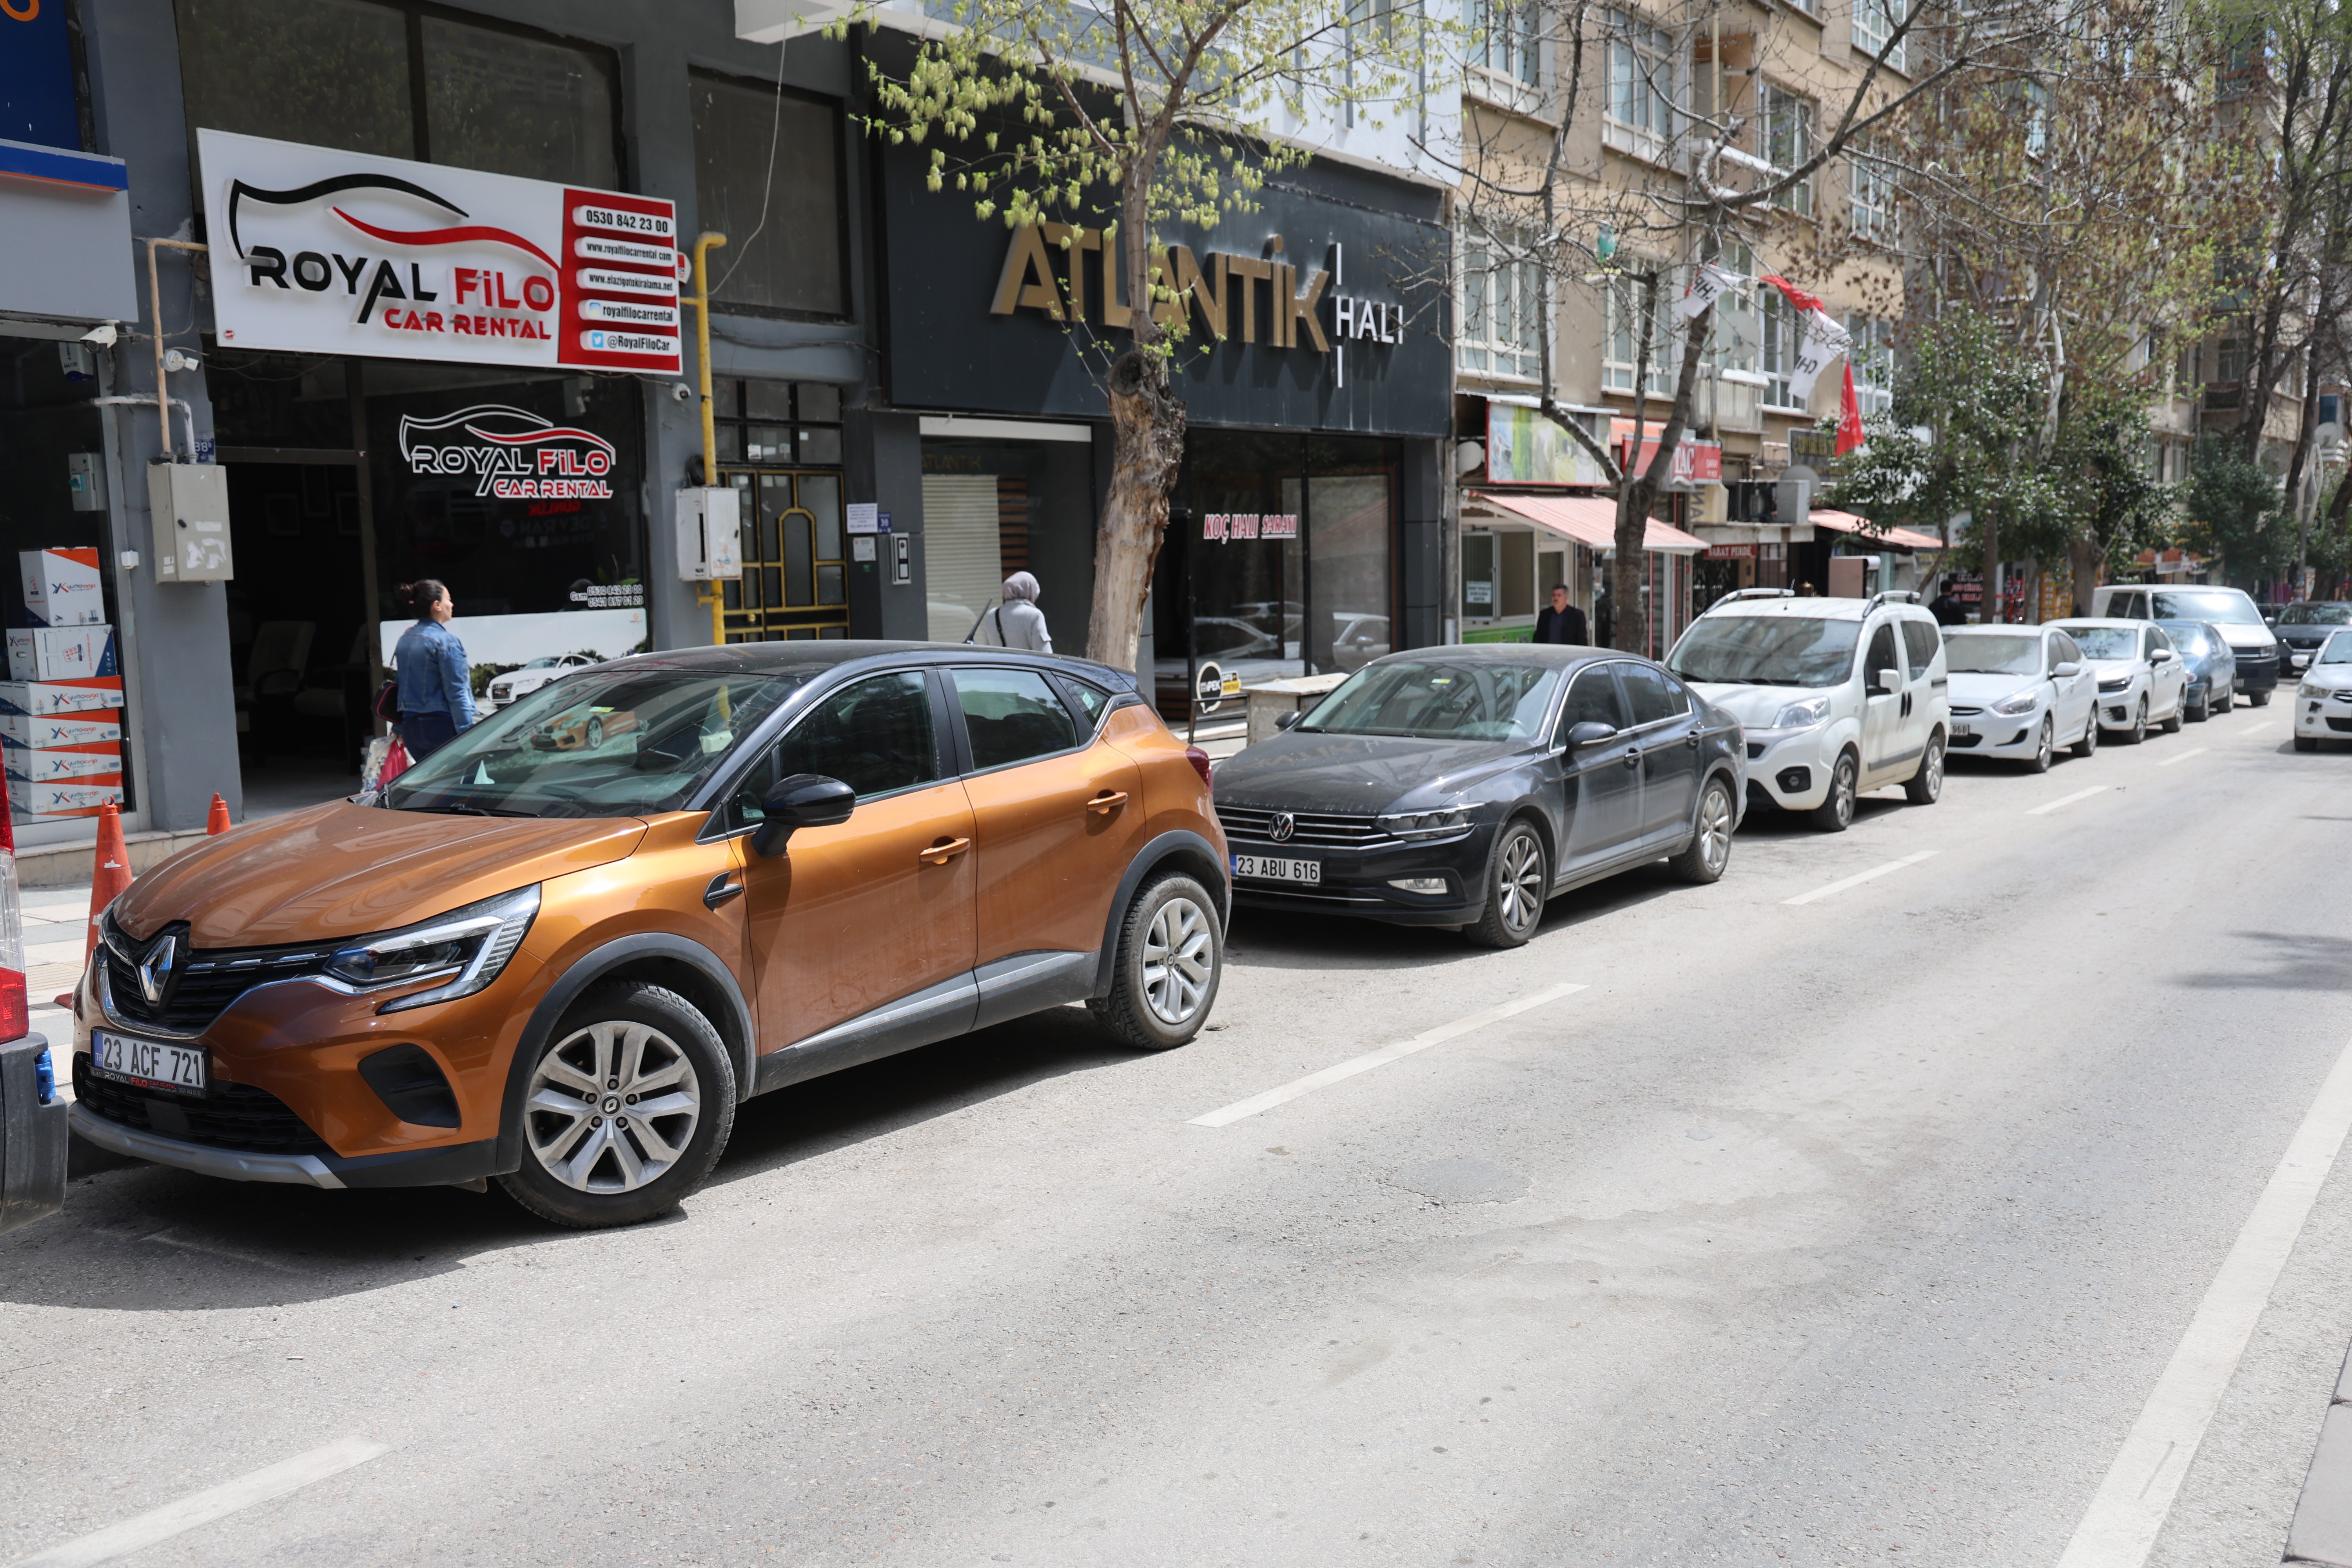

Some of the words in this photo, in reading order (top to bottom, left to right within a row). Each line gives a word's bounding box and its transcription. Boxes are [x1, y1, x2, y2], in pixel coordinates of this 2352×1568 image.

[586, 210, 612, 225] 0530
[617, 214, 636, 228] 842
[640, 218, 652, 230] 23
[656, 220, 668, 232] 00
[249, 245, 437, 325] ROYAL
[384, 308, 445, 333] CAR
[453, 314, 552, 340] RENTAL
[603, 305, 673, 321] royalfilocarrental
[1336, 294, 1403, 345] HALI
[607, 335, 670, 351] @RoyalFiloCar
[410, 445, 534, 497] ROYAL
[493, 478, 541, 499] CAR
[540, 479, 614, 499] RENTAL
[1203, 514, 1230, 544] KOÇ
[1230, 514, 1259, 539] HALI
[1261, 514, 1297, 534] SARAYI
[1238, 857, 1254, 874] 23
[1261, 859, 1286, 877] ABU
[1294, 862, 1318, 880] 616
[96, 1053, 103, 1062] TR
[104, 1037, 122, 1070] 23
[131, 1043, 160, 1077] ACF
[170, 1050, 200, 1085] 721
[104, 1071, 130, 1084] ROYAL
